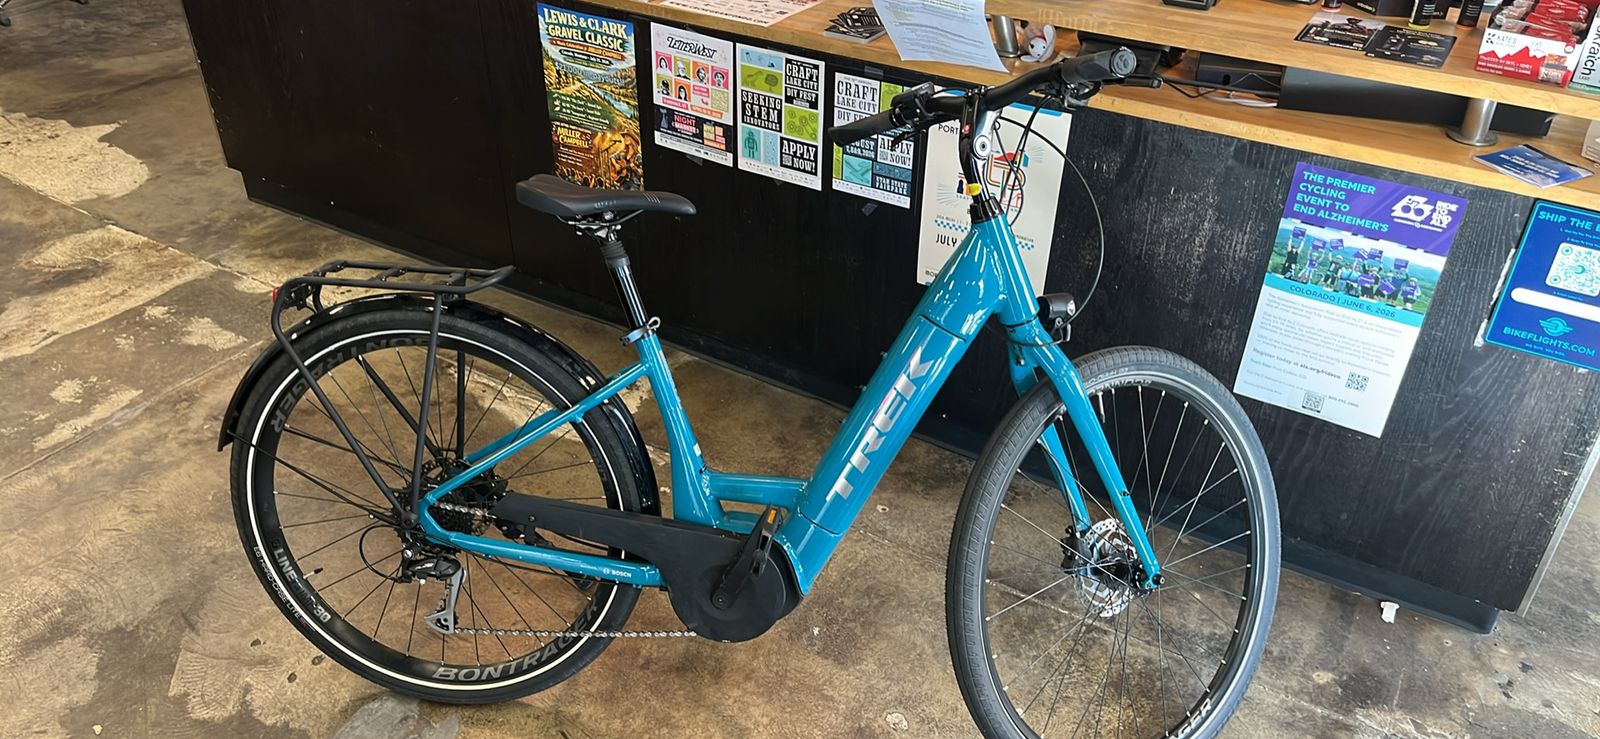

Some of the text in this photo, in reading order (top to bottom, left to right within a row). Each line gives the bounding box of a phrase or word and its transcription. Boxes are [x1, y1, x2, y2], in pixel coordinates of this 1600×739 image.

[543, 8, 628, 39] LEWIS & CLARK
[548, 25, 624, 51] GRAVEL CLASSIC
[786, 62, 818, 82] CRAFT
[786, 76, 818, 91] LAKE CITY
[837, 80, 878, 102] CRAFT
[742, 90, 780, 110] SEEKING
[786, 87, 817, 102] DIY FEST
[745, 104, 778, 123] STEM
[836, 95, 878, 114] LAKE CITY
[674, 114, 696, 126] NIGHT
[743, 115, 780, 131] INNOVATORS
[837, 109, 852, 121] DIY
[557, 127, 581, 140] MILLER
[559, 135, 589, 148] CAMPBELL
[782, 140, 816, 161] APPLY
[890, 153, 911, 167] NOW!
[793, 157, 816, 173] NOW!
[1299, 183, 1346, 200] CYCLING
[1303, 171, 1376, 195] THE PREMIER
[1296, 193, 1350, 212] EVENT TO
[1293, 203, 1389, 232] END ALZHEIMER'S
[1538, 211, 1567, 224] SHIP
[1570, 217, 1592, 230] THE
[935, 233, 958, 248] JULY
[1289, 284, 1395, 318] COLORADO JUNE 6, 2026
[1503, 327, 1596, 356] BIKEFLIGHTS.COM
[825, 346, 934, 502] TREK
[273, 548, 298, 582] LINE
[611, 569, 632, 578] BOSCH
[313, 604, 332, 623] 30
[432, 601, 597, 682] BONTRAGER
